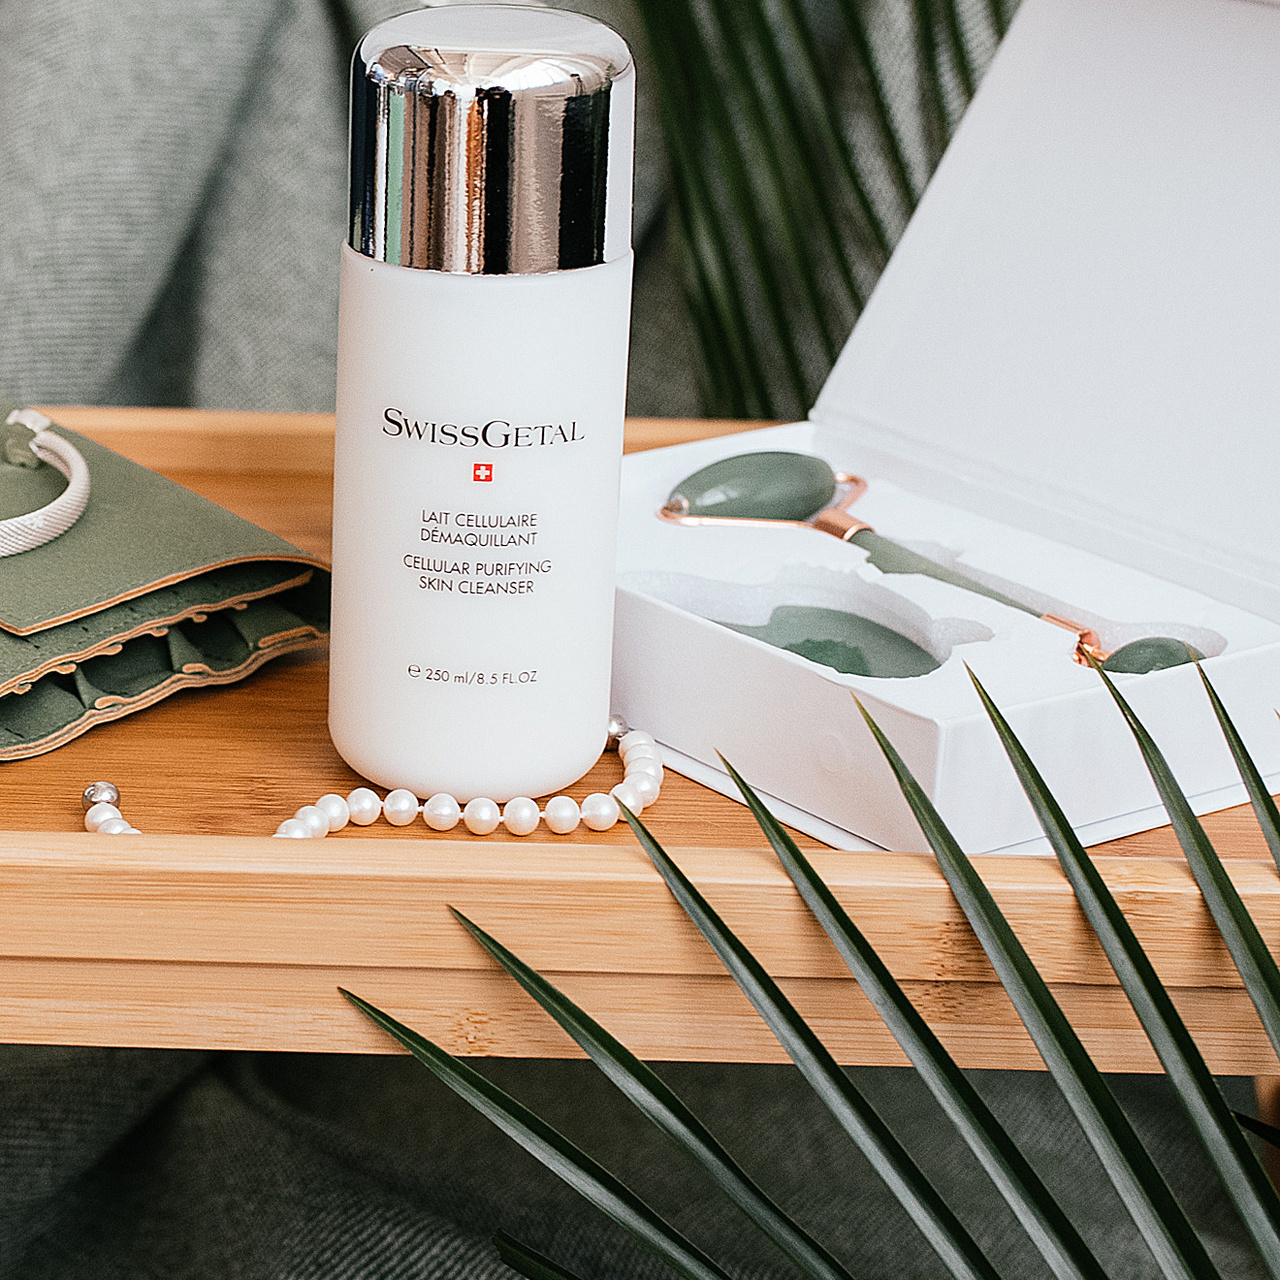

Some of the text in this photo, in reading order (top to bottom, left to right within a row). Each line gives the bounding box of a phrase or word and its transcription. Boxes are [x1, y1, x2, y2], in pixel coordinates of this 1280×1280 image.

[422, 509, 538, 528] LAIT CELLULAIRE
[420, 526, 538, 547] DÉMAQUILLANT
[403, 554, 552, 576] CELLULAR PURIFYING
[419, 575, 534, 595] SKIN CLEANSER
[425, 668, 450, 682] 250
[453, 671, 498, 685] ml/8.5
[502, 670, 538, 684] FL.OZ
